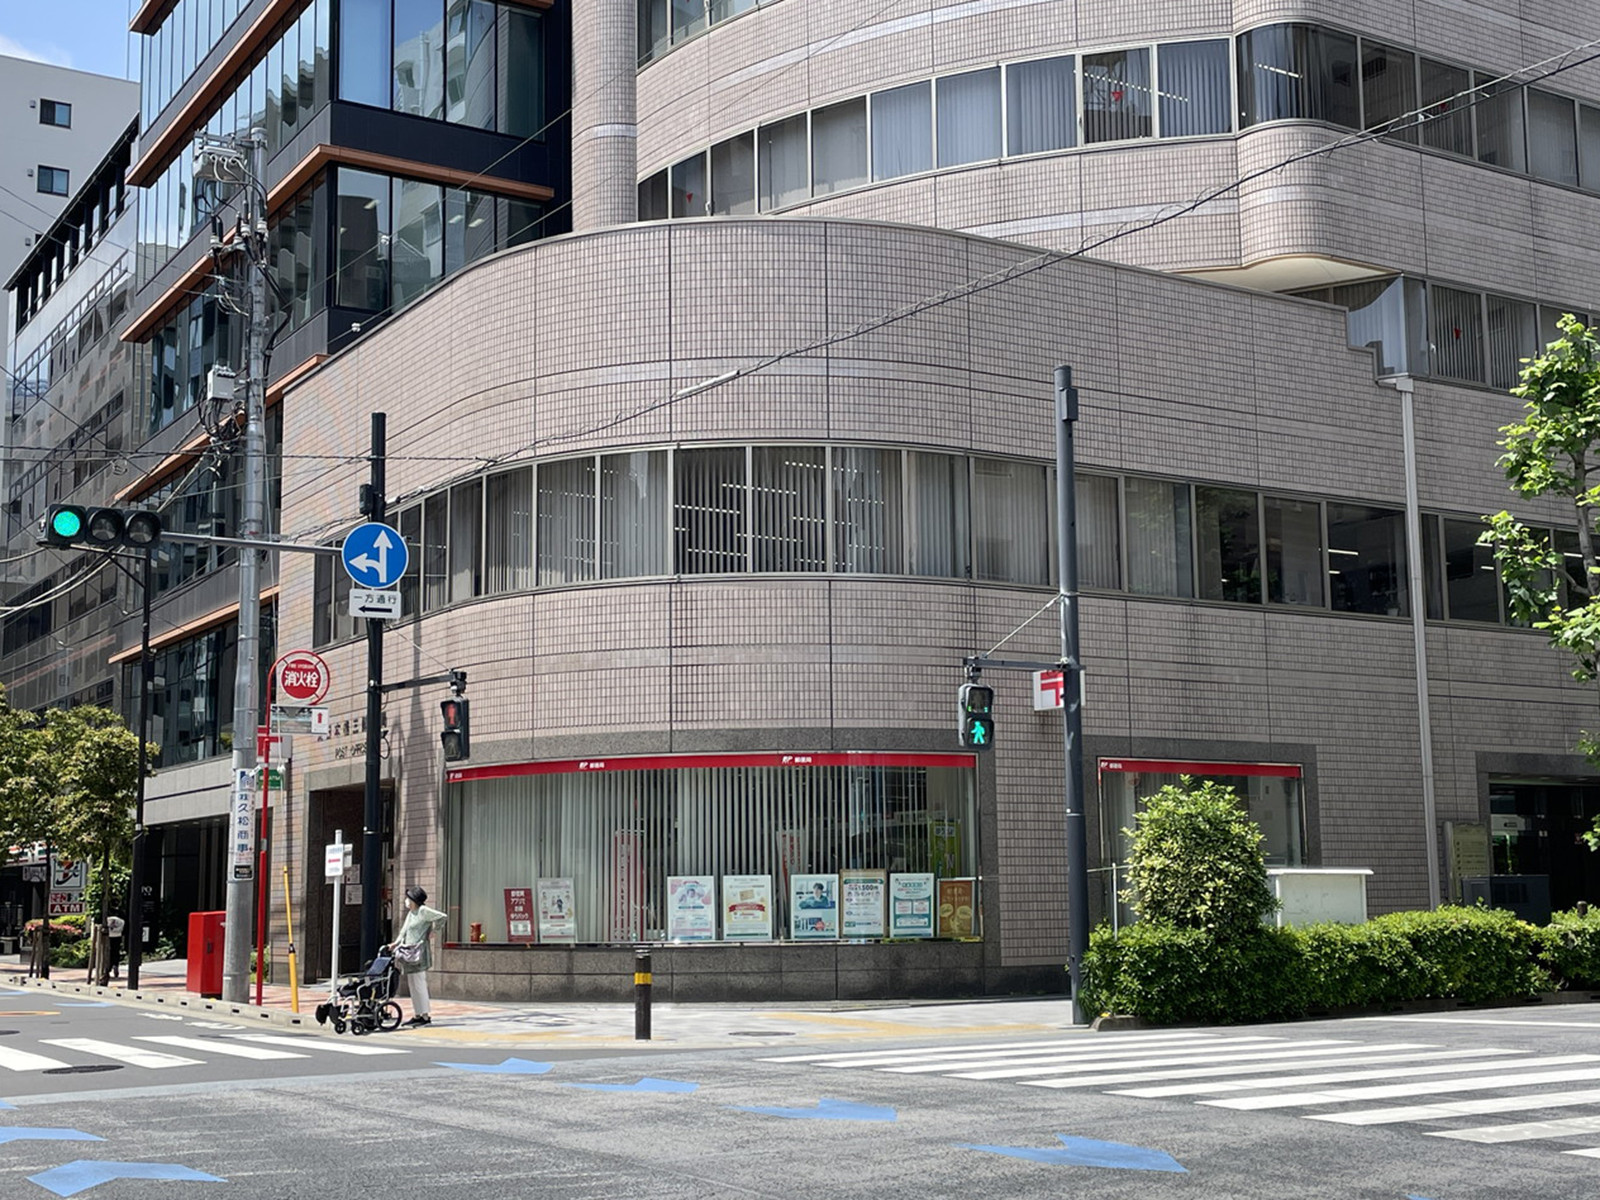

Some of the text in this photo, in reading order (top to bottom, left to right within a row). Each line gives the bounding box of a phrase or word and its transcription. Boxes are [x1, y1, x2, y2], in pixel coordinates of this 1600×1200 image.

[353, 593, 396, 605] 一方通行
[284, 670, 319, 688] 消火栓
[53, 904, 80, 913] ATM
